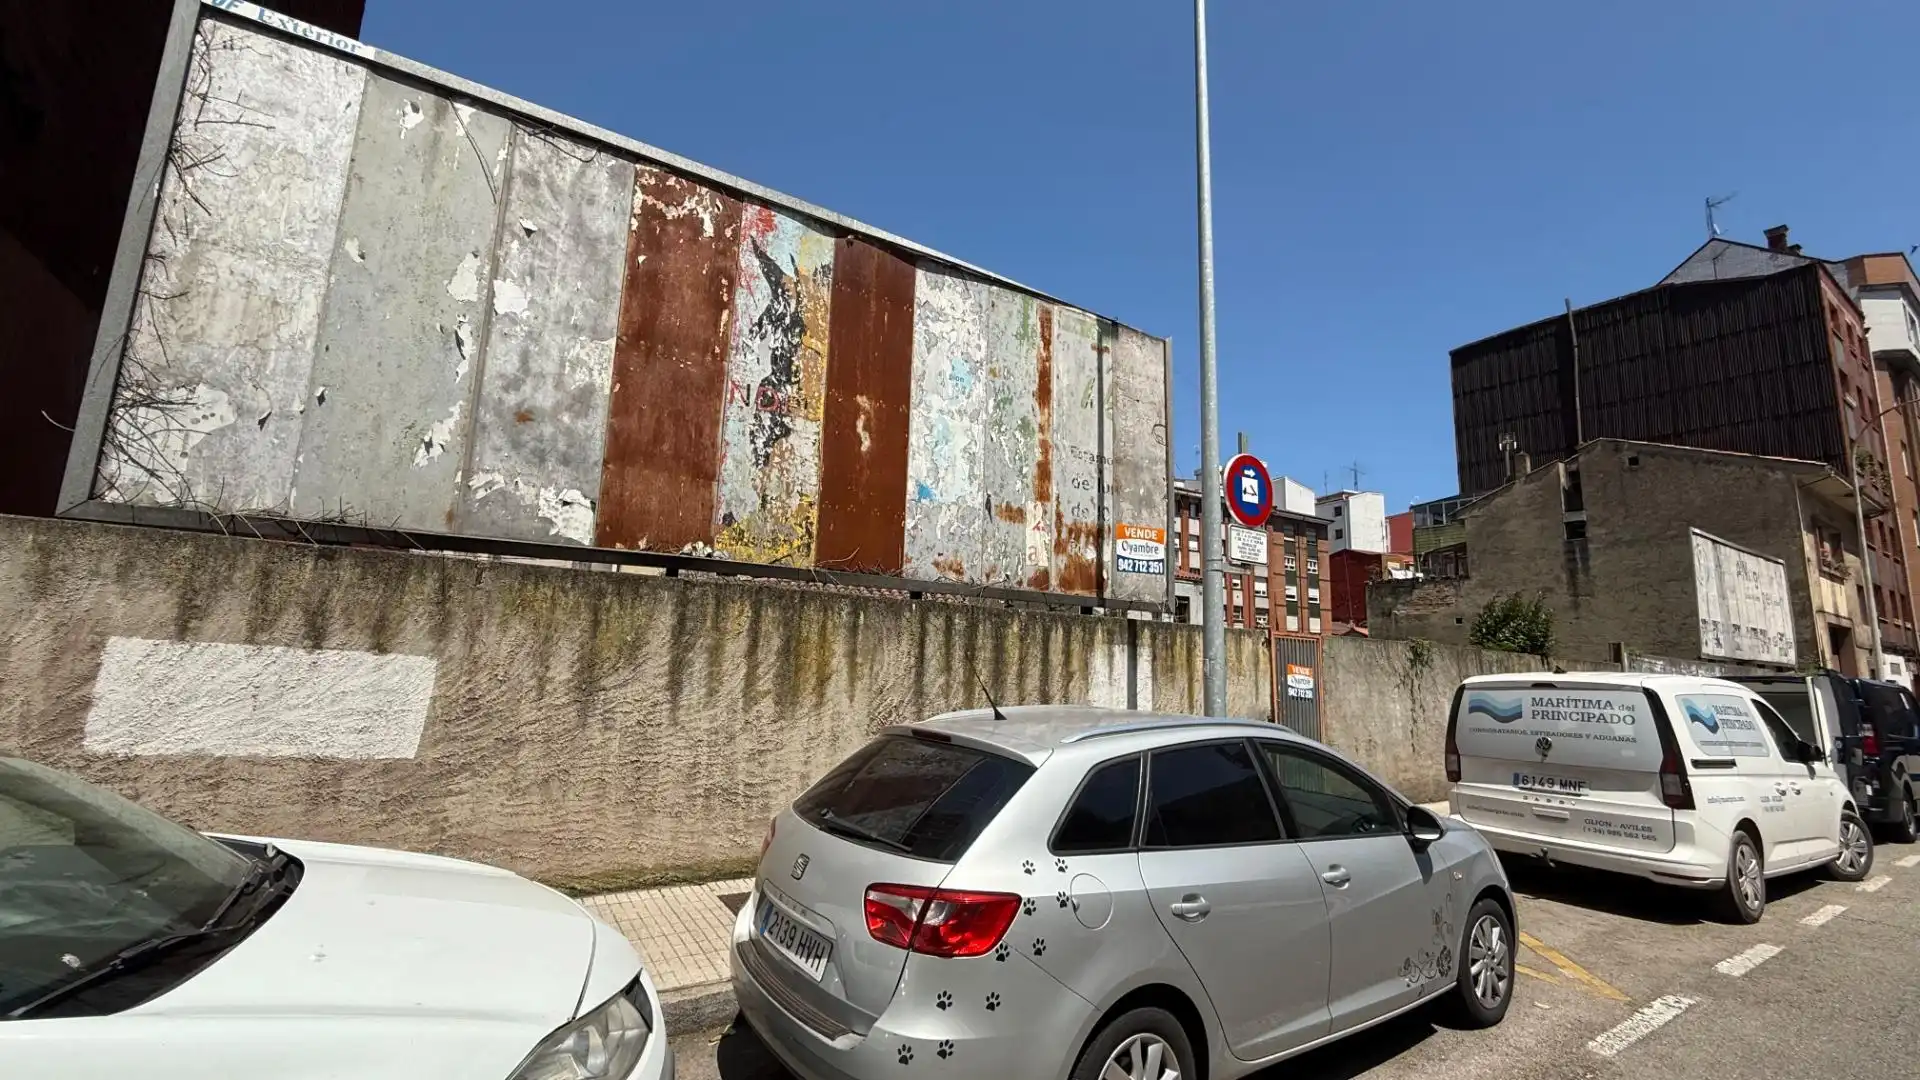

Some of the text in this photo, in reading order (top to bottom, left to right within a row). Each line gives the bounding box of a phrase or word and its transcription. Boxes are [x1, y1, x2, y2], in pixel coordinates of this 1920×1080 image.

[258, 8, 362, 53] Exterior
[1124, 526, 1159, 540] VENDE
[1121, 540, 1160, 555] Oyambre
[1118, 558, 1163, 574] 942 712 351
[1531, 696, 1635, 712] MARÍTIMA del
[1531, 709, 1636, 726] PRINCIPADO
[1593, 734, 1637, 743] ADUANAS
[1521, 775, 1586, 792] 6149 MNF
[769, 911, 826, 973] 2139 HVH
